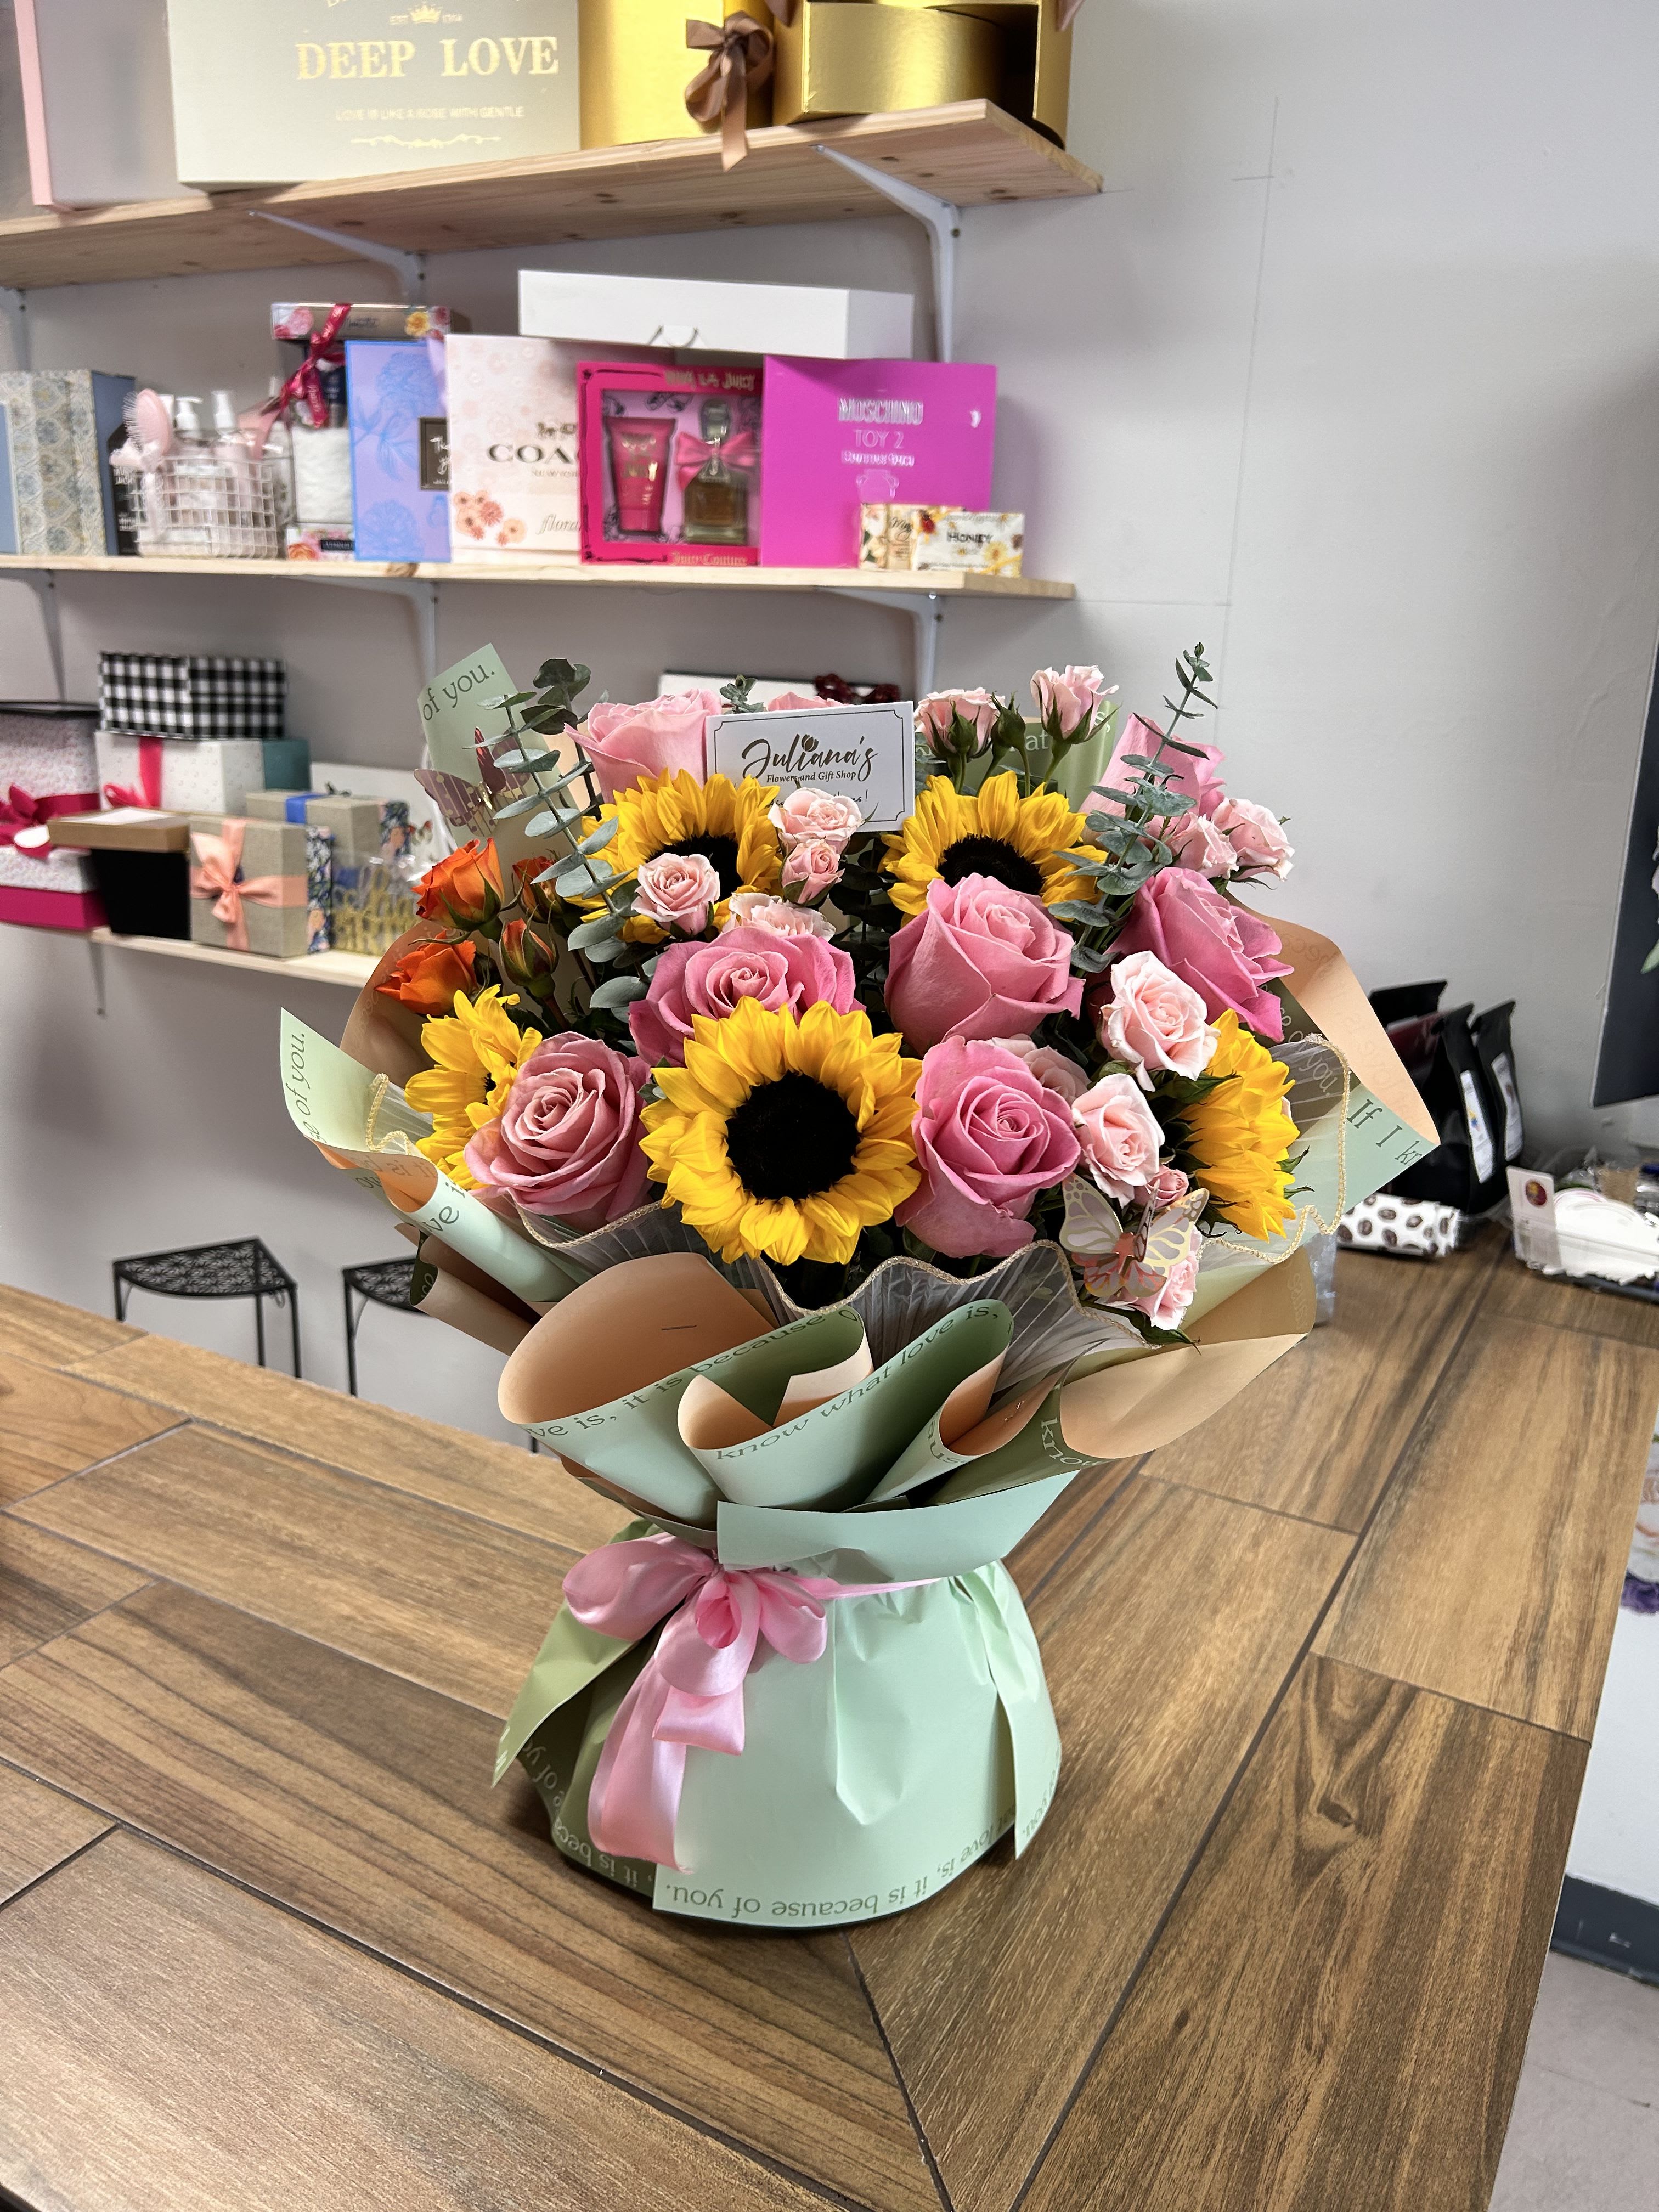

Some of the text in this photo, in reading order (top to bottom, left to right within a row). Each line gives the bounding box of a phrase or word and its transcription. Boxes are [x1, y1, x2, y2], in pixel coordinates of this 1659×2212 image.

[295, 37, 558, 80] DEEP LOVE
[838, 398, 924, 425] MOSCHINO
[854, 428, 905, 449] TOY 2
[487, 443, 578, 464] COA
[535, 513, 581, 535] flora
[946, 531, 994, 544] HONEY
[423, 664, 495, 721] of you.
[741, 733, 879, 782] Juliana's
[766, 770, 856, 783] Flowers and Gift Shop
[285, 1032, 311, 1116] of you.
[1346, 1098, 1423, 1166] If I kn
[422, 1205, 460, 1232] ve
[526, 1309, 859, 1437] ve is, it is because o
[715, 1305, 998, 1460] know what love is,
[666, 1884, 725, 1910] you.
[888, 1885, 907, 1905] is
[915, 1876, 928, 1898] it
[731, 1896, 761, 1919] of
[771, 1894, 878, 1917] because
